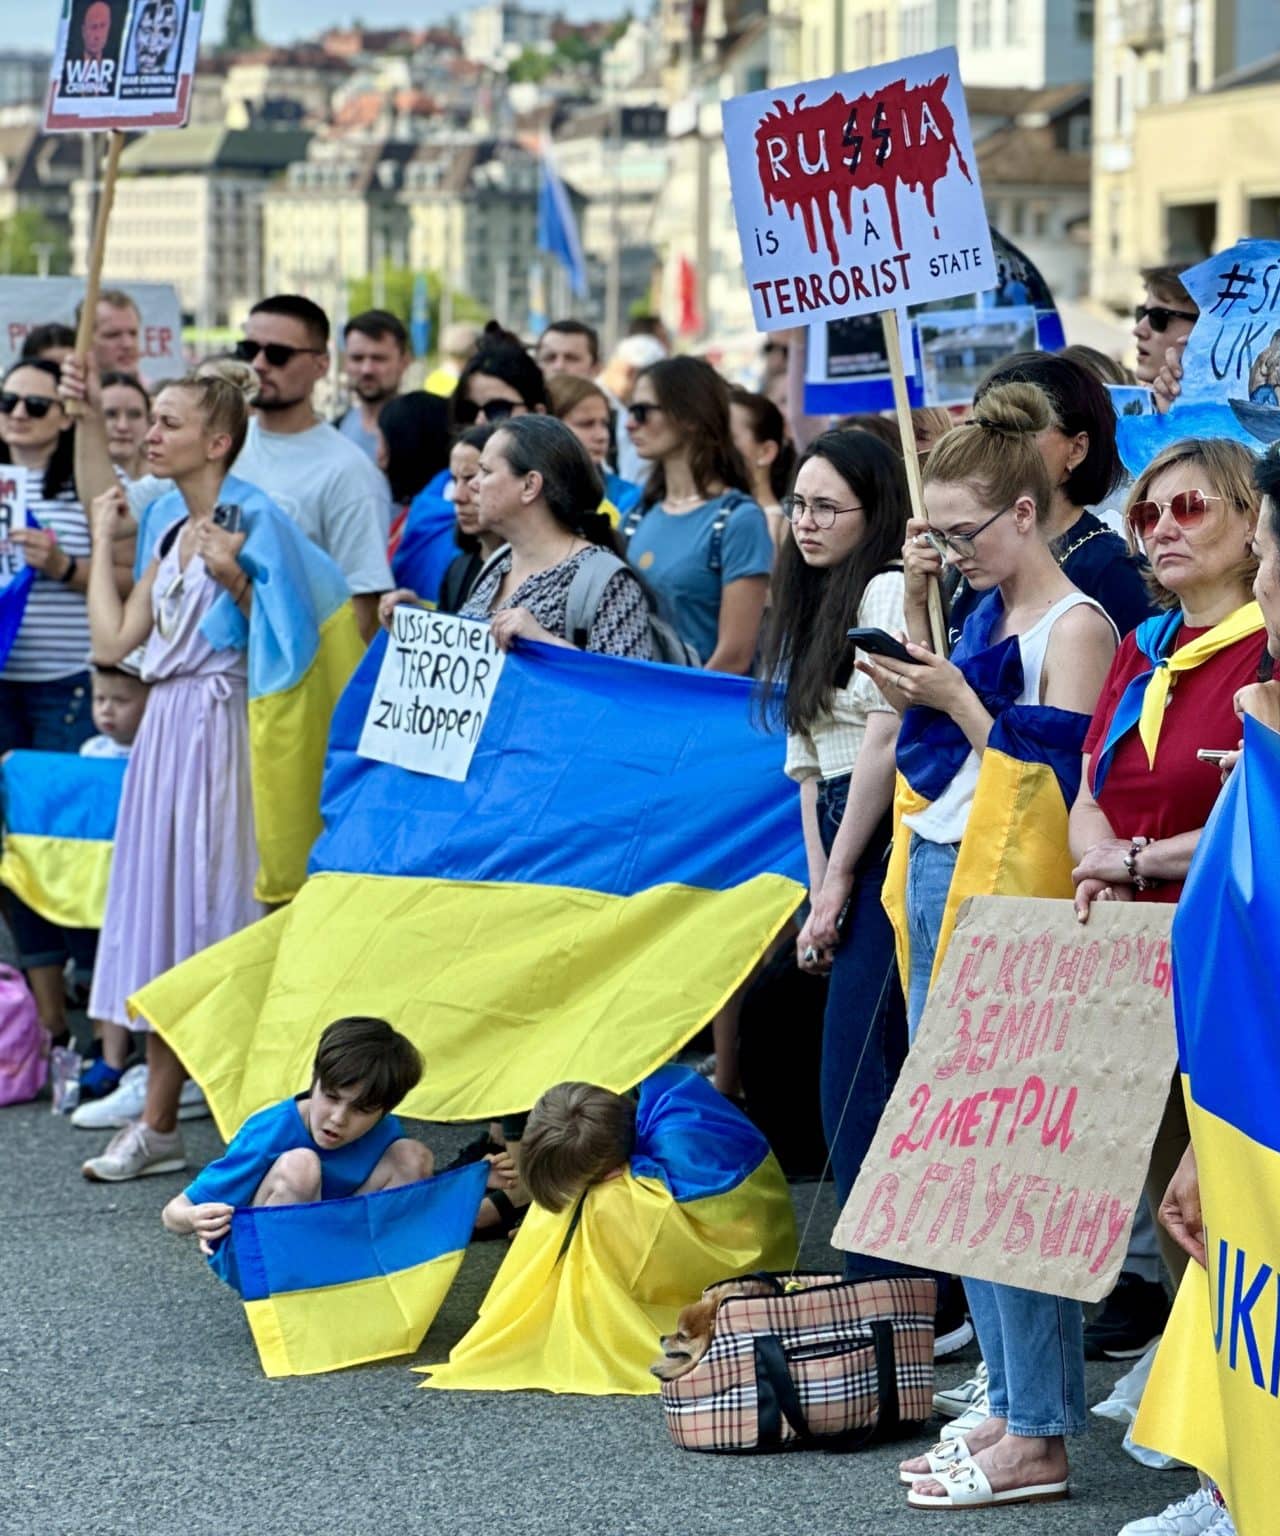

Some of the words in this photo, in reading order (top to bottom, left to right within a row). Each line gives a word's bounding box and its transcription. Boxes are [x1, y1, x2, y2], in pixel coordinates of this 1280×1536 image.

[66, 59, 115, 82] WAR
[767, 101, 943, 181] RUSSIA
[864, 219, 880, 245] A
[753, 253, 912, 318] TERRORIST
[930, 248, 982, 277] STATE
[391, 612, 500, 656] ussischen
[396, 647, 490, 699] TERROR
